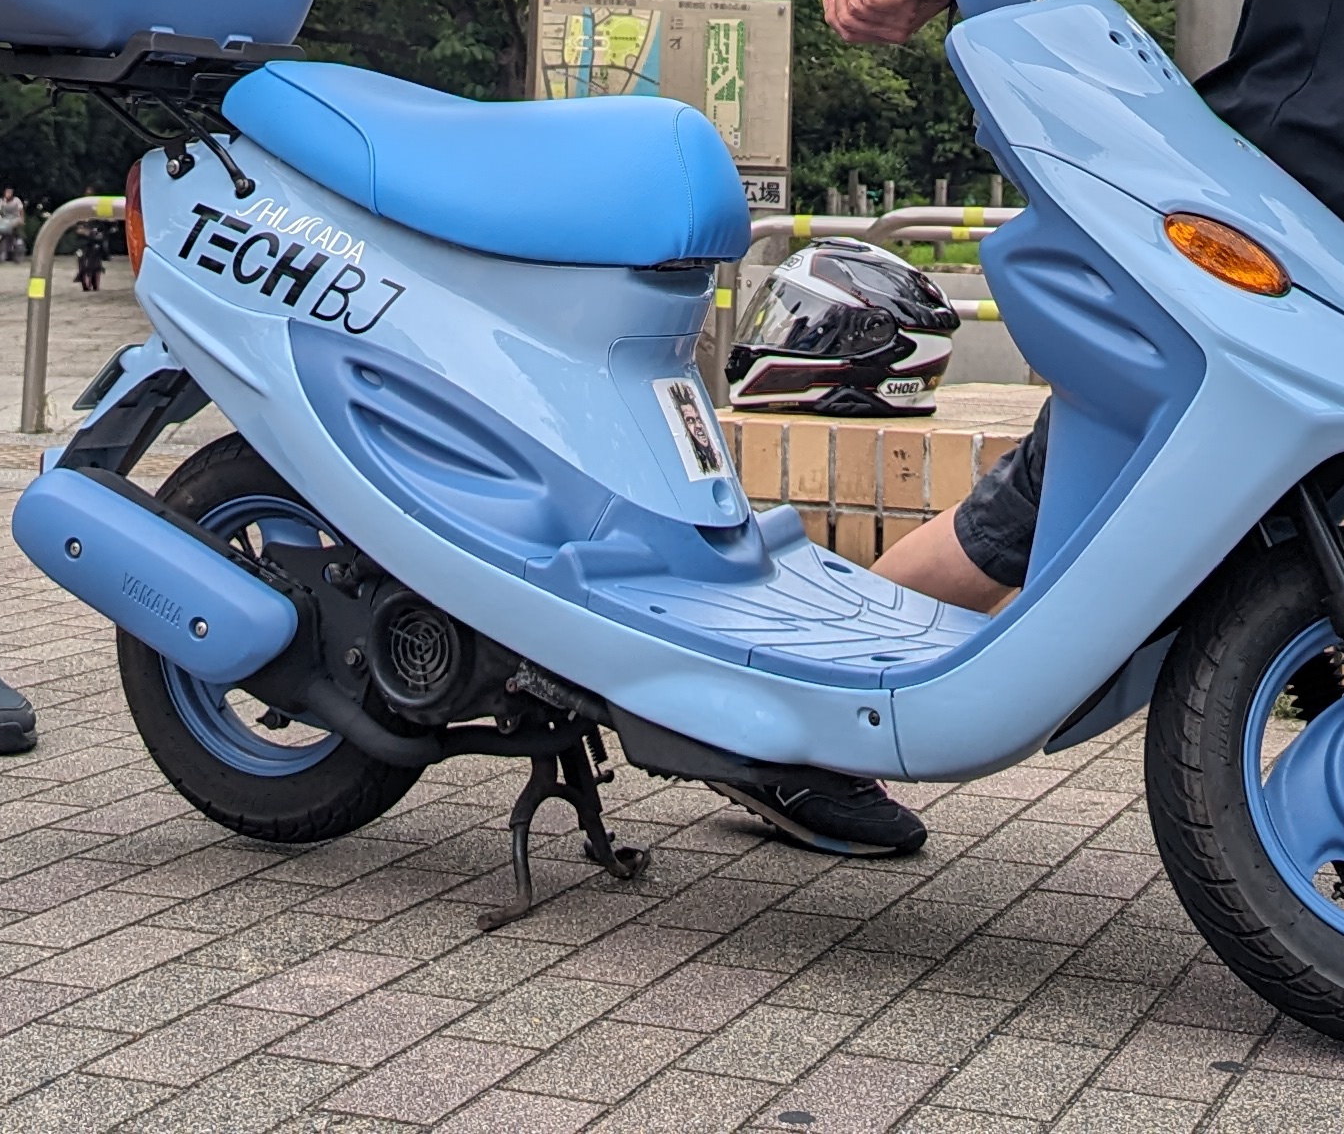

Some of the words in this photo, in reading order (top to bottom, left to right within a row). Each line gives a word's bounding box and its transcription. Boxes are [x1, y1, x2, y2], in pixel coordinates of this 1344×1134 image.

[178, 202, 330, 307] TECH
[309, 263, 407, 335] BJ
[885, 382, 920, 395] SHOEI
[122, 572, 183, 629] YAMAHA
